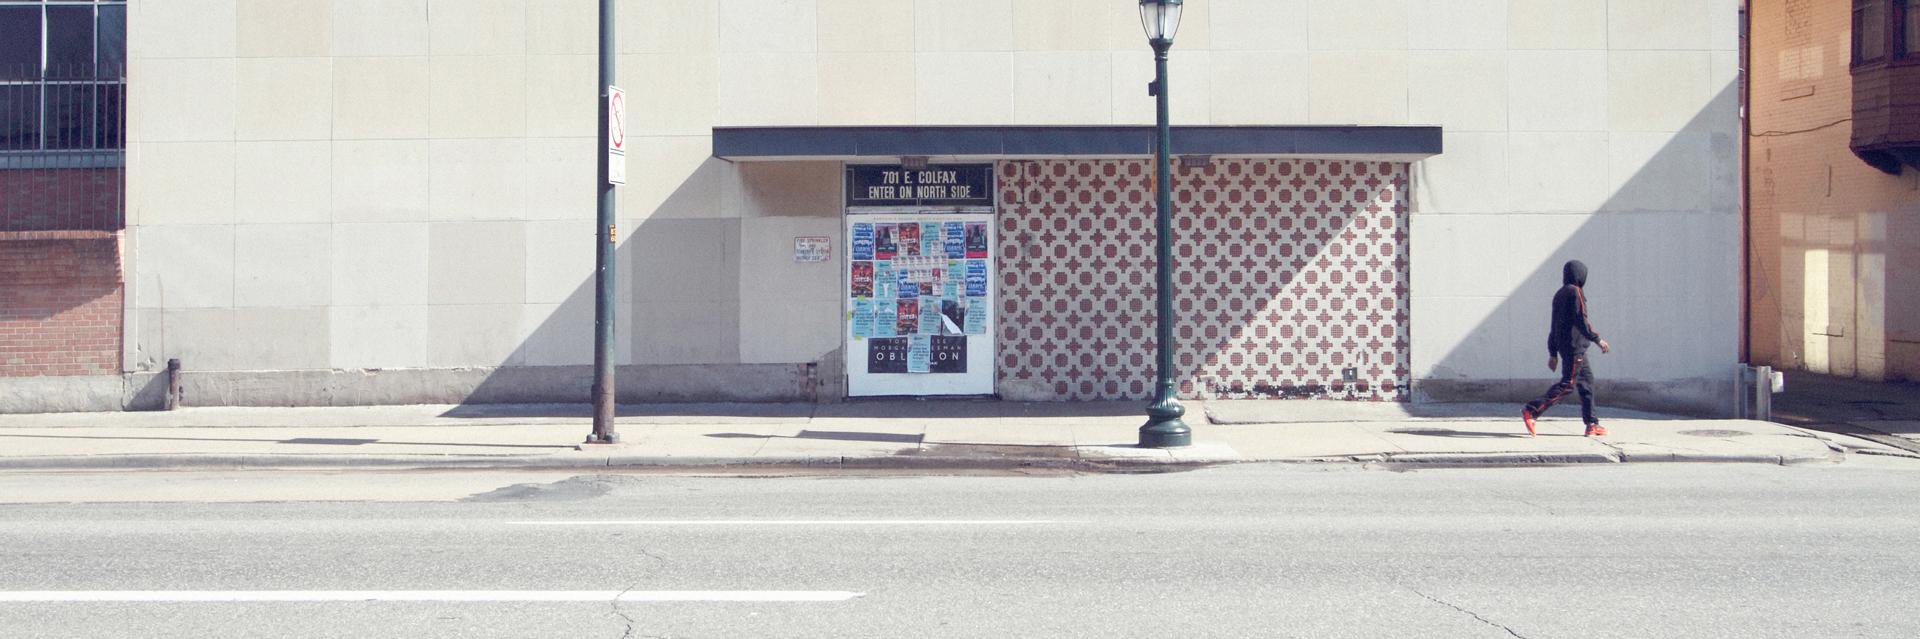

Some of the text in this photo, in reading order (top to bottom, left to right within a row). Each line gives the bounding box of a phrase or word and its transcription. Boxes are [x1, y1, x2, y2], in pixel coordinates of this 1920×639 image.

[882, 171, 957, 184] 701 E. COLFAX
[868, 185, 971, 199] ENTER ON NORTH SIDE
[876, 352, 959, 361] OBLION
